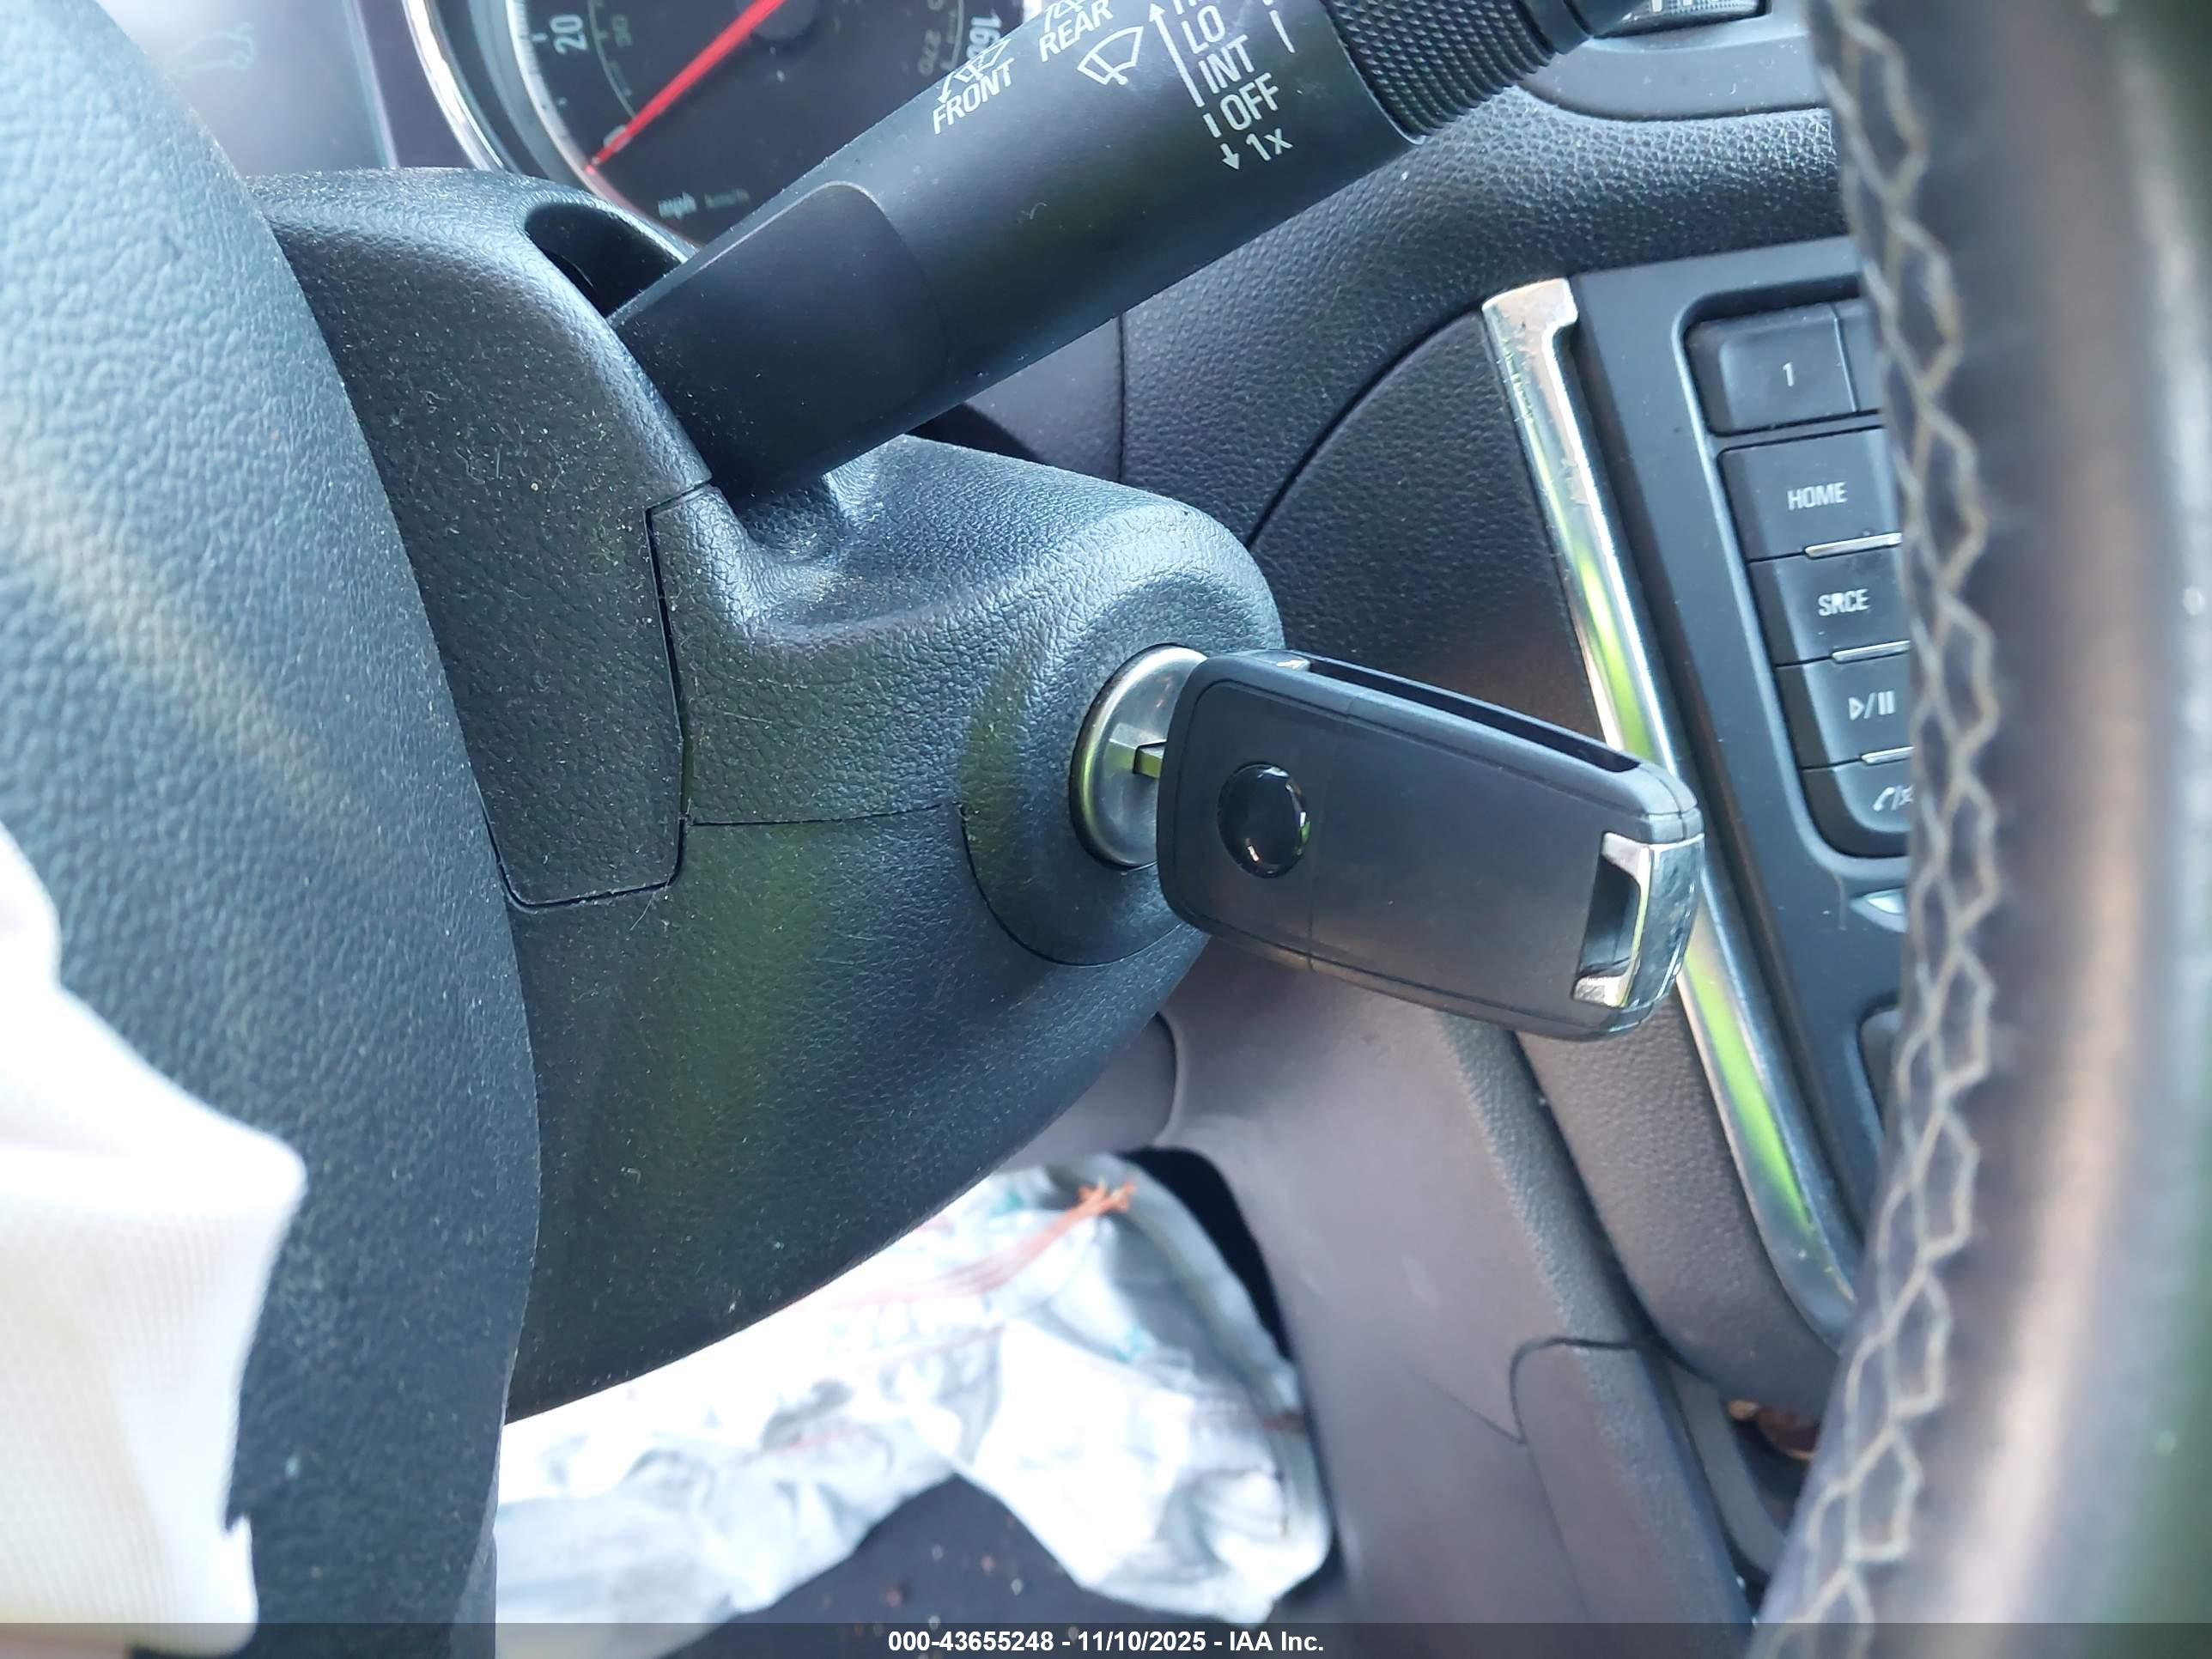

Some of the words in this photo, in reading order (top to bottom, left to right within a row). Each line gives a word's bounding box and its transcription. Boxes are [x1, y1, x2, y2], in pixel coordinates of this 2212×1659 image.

[550, 14, 588, 55] 20
[1039, 0, 1113, 62] REAR
[1182, 5, 1225, 54] LO
[1198, 34, 1255, 94] INT
[933, 58, 1014, 135] FRONT
[1220, 72, 1279, 131] OFF
[1246, 128, 1293, 161] 1x
[1782, 362, 1796, 387] 1
[1787, 481, 1848, 510] HOME
[1818, 588, 1870, 617] SRCE
